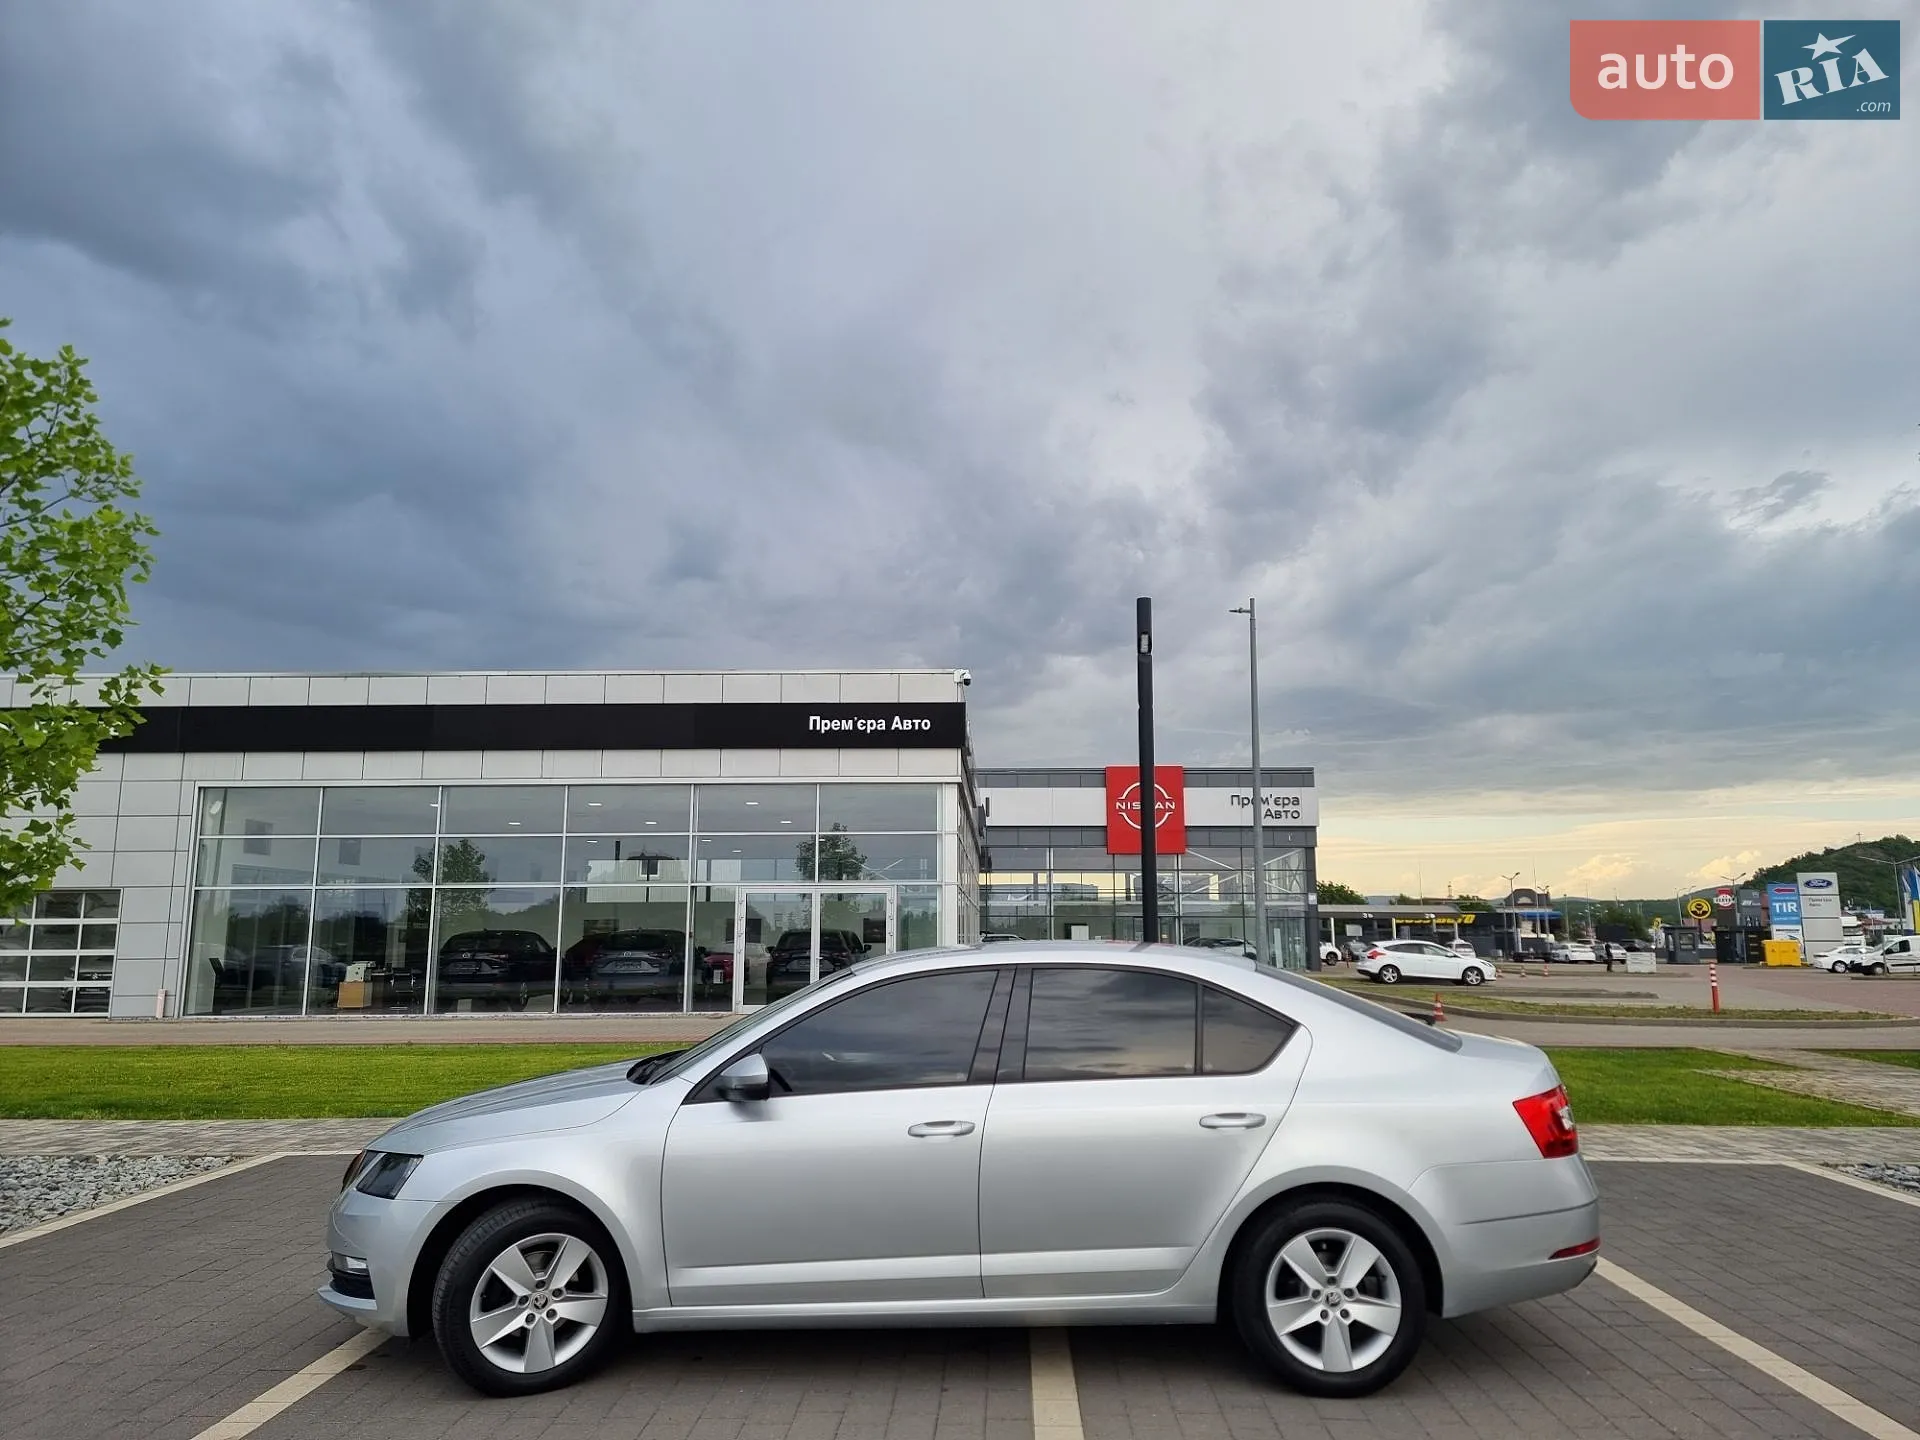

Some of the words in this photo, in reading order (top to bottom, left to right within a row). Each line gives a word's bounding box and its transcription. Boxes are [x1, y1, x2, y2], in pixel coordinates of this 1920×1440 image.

[808, 715, 886, 734] Прем'єра
[890, 715, 931, 731] Авто
[1115, 801, 1176, 810] NISAN
[1263, 808, 1301, 820] Авто
[1772, 901, 1798, 913] TIR
